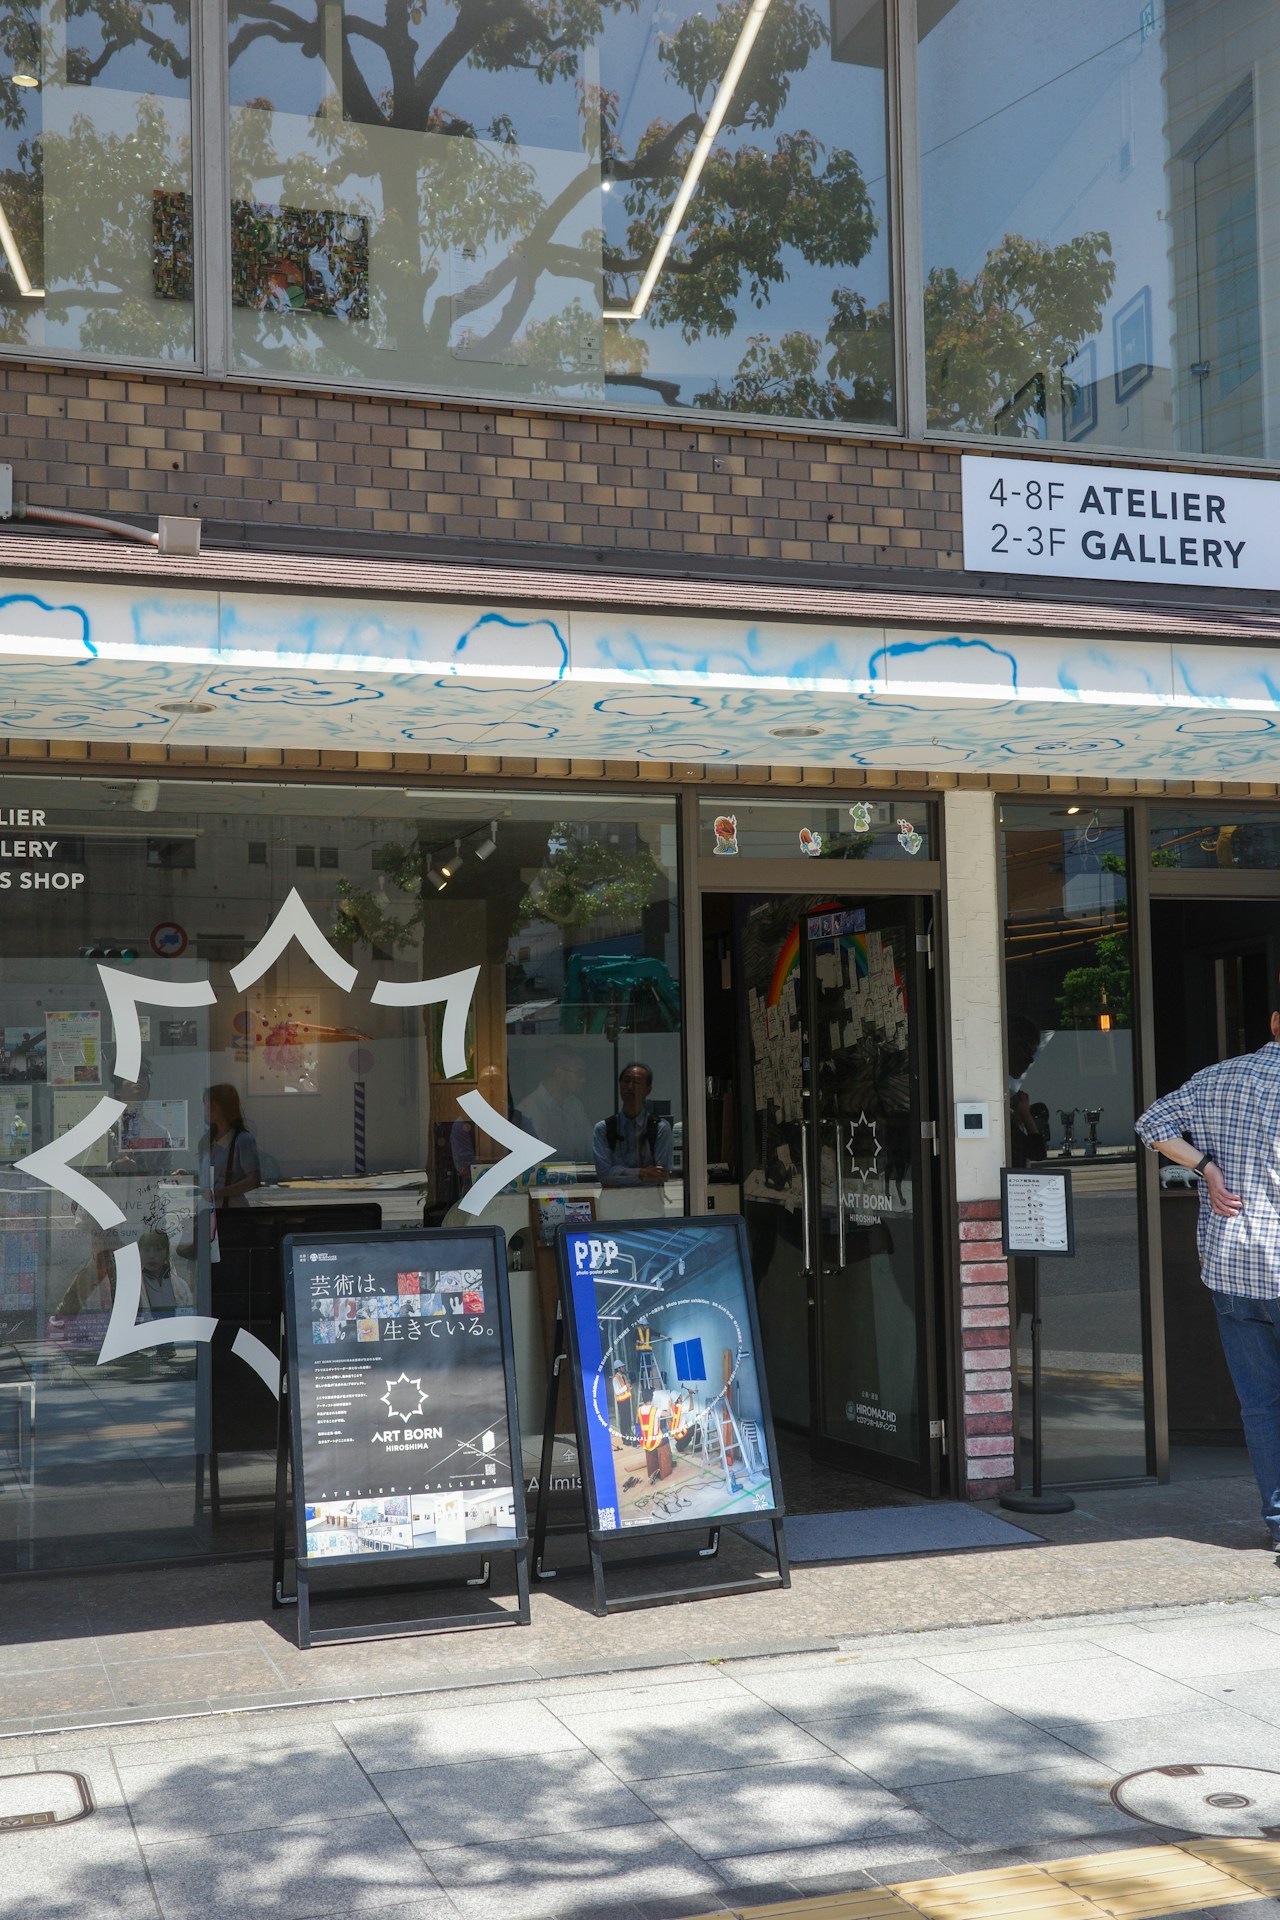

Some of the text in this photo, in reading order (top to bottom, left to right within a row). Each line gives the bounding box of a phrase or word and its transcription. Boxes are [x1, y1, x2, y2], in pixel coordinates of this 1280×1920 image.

[989, 478, 1226, 524] 4-8F ATELIER
[991, 523, 1246, 569] 2-3F GALLERY
[0, 840, 58, 858] LERY
[20, 872, 85, 890] SHOP
[840, 1192, 893, 1211] ART BORN
[849, 1213, 882, 1225] HIROSHIMA
[120, 1230, 138, 1238] SUN
[310, 1273, 386, 1297] 芸術は、
[383, 1317, 494, 1342] 生きている。
[371, 1427, 443, 1443] ART BORN
[386, 1442, 429, 1452] HIROSHIMA
[562, 1448, 576, 1463] 全
[321, 1486, 396, 1499] ATELIER
[424, 1478, 498, 1491] GALLERY
